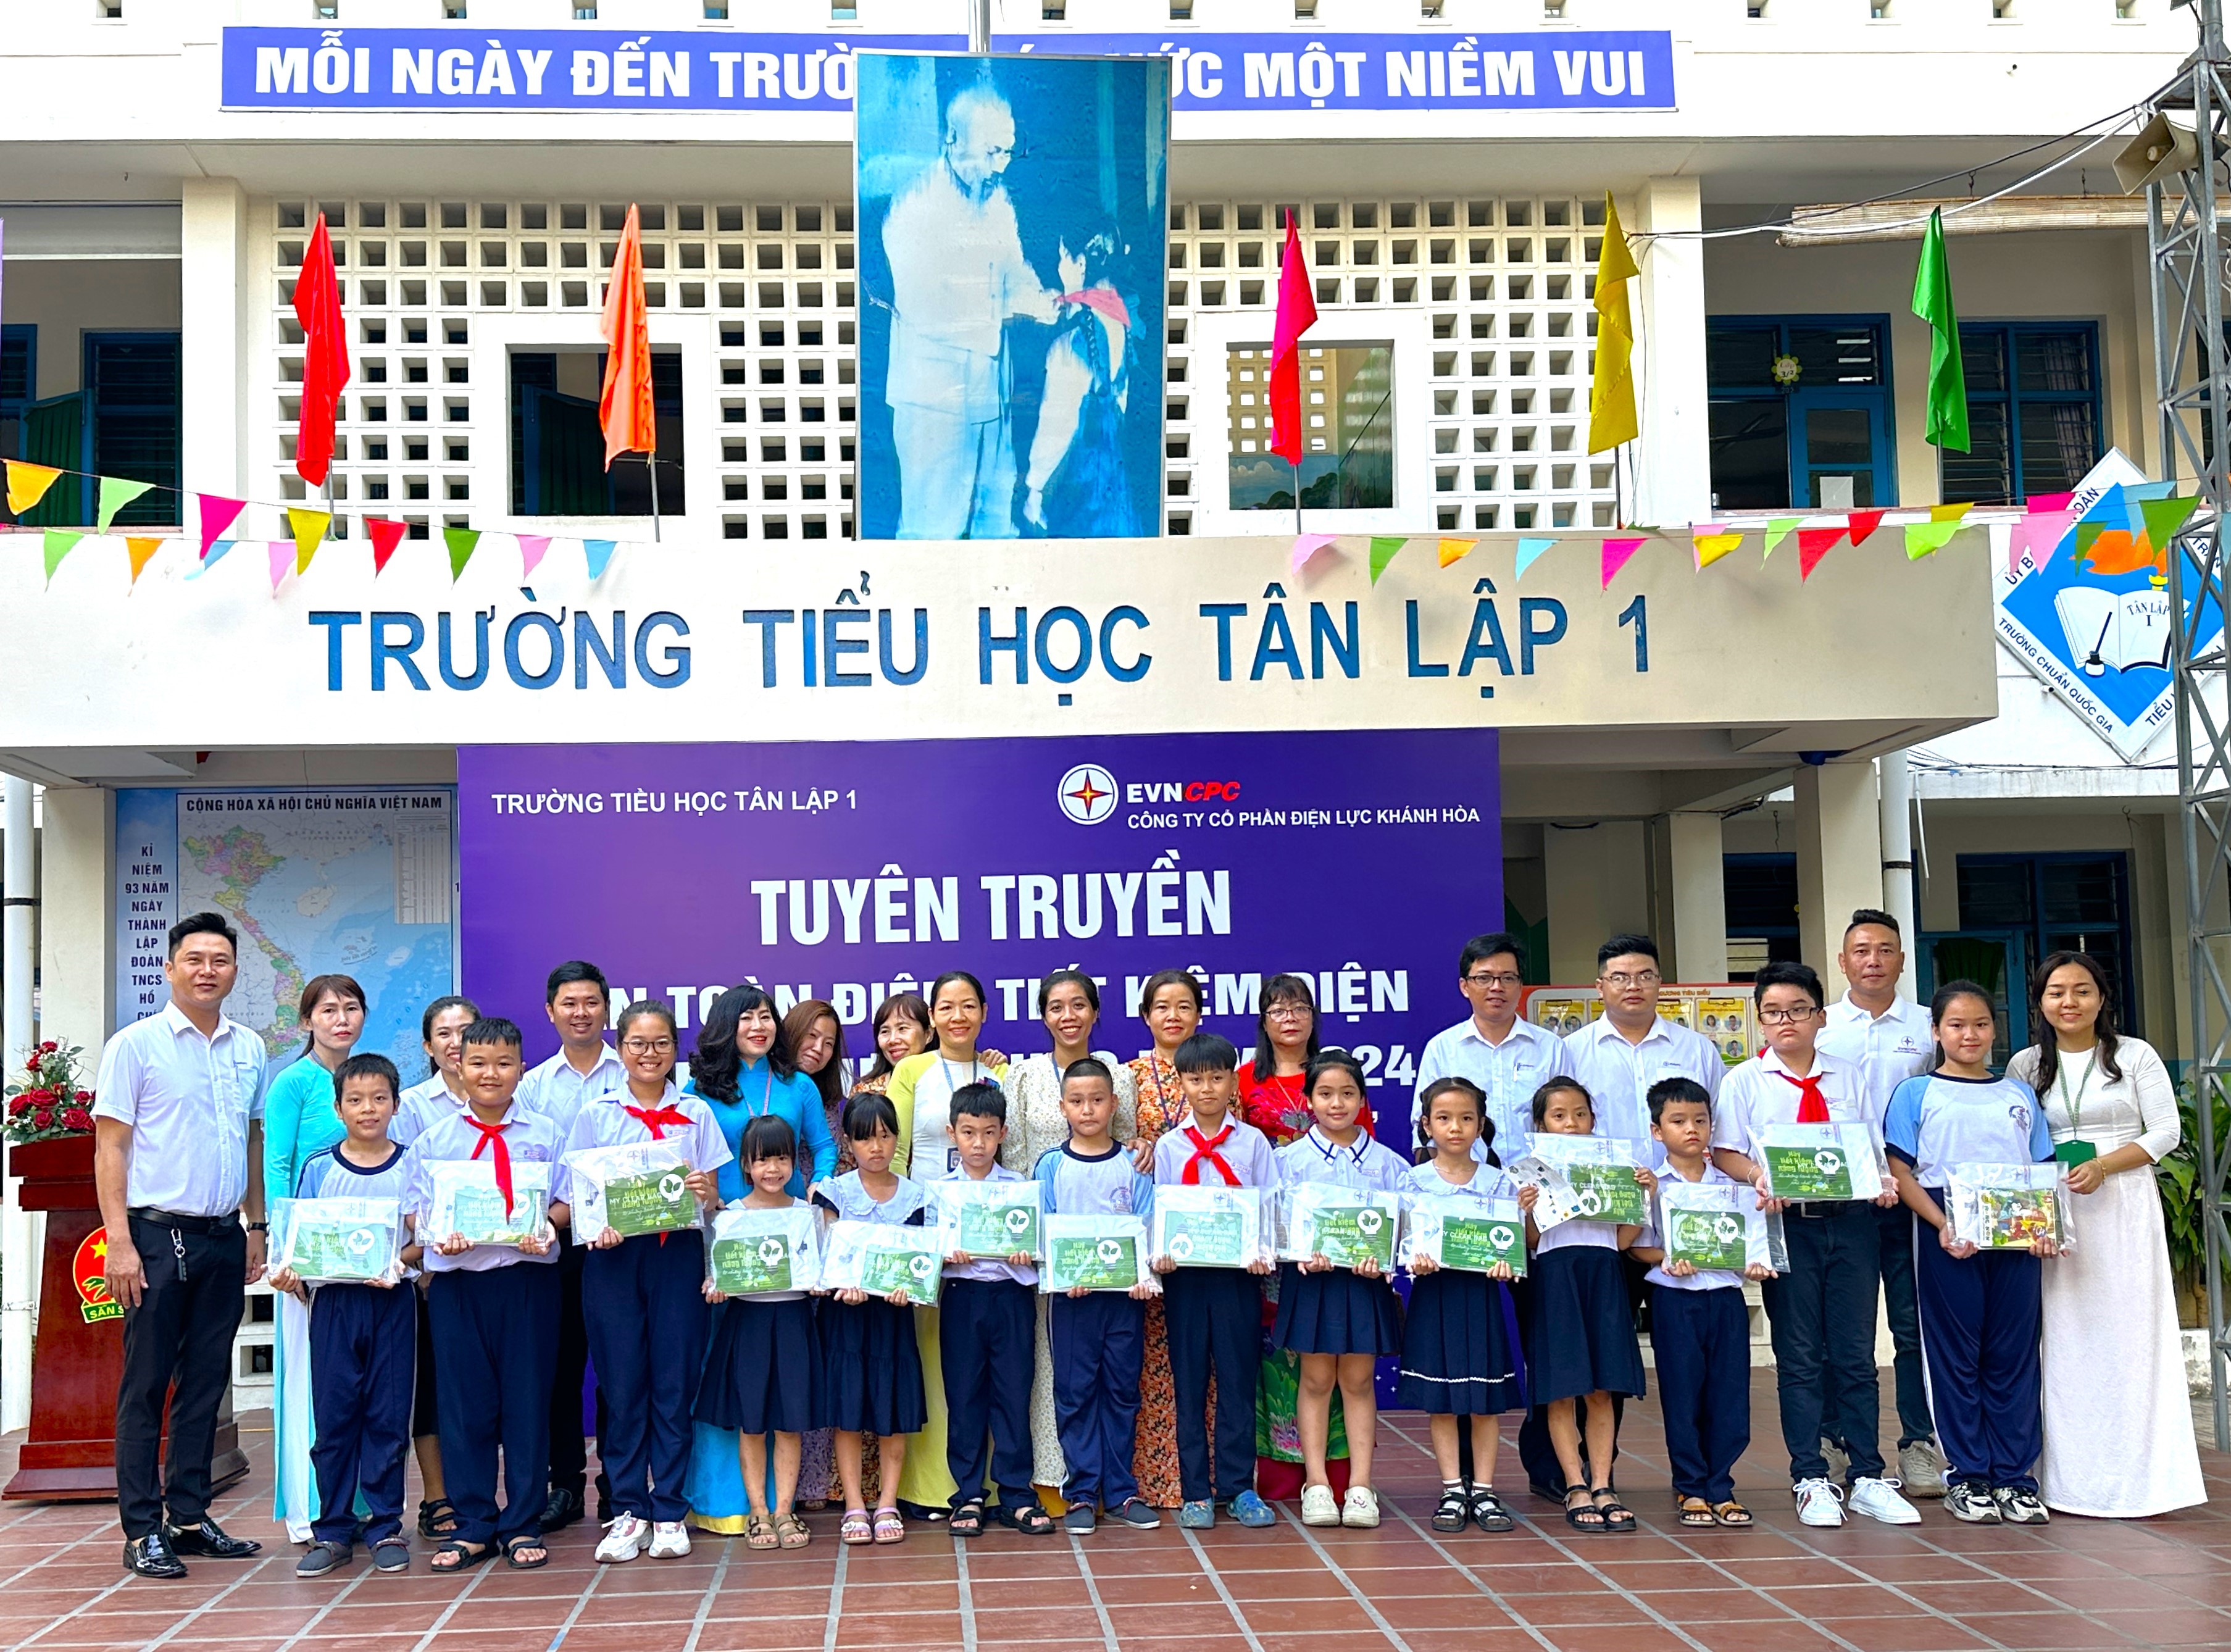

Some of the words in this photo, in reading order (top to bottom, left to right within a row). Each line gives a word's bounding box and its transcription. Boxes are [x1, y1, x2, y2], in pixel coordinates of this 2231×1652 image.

[256, 30, 370, 94] MỖI
[392, 39, 553, 95] NGÀY
[570, 36, 690, 97] ĐẾN
[710, 42, 854, 100] TRƯỜ
[1243, 42, 1367, 107] MỘT
[1386, 36, 1535, 97] NIỀM
[1553, 51, 1645, 96] VUI
[2074, 487, 2100, 515] DÂN
[2127, 599, 2148, 615] TÂN
[308, 587, 691, 691] TRƯỜNG
[743, 570, 928, 688] TIỂU
[978, 605, 1153, 706] HỌC
[1199, 582, 1377, 682] TÂN
[1406, 578, 1568, 699] LẬP
[1618, 594, 1649, 673] 1
[1999, 617, 2037, 657] TRƯỜNG
[2037, 656, 2070, 690] CHUẨN
[2069, 688, 2096, 715] QUỐC
[2096, 714, 2113, 733] GIA
[2145, 699, 2173, 726] TIỂU
[186, 797, 223, 813] CỘNG
[227, 796, 254, 811] HÒA
[257, 796, 275, 811] XÃ
[278, 796, 301, 812] HỘI
[305, 795, 332, 809] CHỦ
[335, 796, 377, 810] NGHĨA
[379, 795, 409, 812] VIỆT
[411, 796, 442, 809] NAM
[491, 788, 603, 814] TRƯỜNG
[674, 791, 727, 817] HỌC
[733, 786, 783, 811] TÂN
[791, 786, 838, 815] LẬP
[846, 790, 856, 809] 1
[1127, 811, 1178, 829] CÔNG
[1182, 812, 1204, 827] TY
[1290, 809, 1330, 828] ĐIỆN
[1336, 809, 1372, 827] LỰC
[1377, 804, 1437, 824] KHÁNH
[1442, 804, 1480, 822] HÒA
[141, 842, 153, 857] KỈ
[132, 862, 162, 877] NIỆM
[125, 883, 139, 894] 93
[142, 881, 169, 894] NĂM
[131, 899, 163, 912] NGÀY
[751, 864, 959, 945] TUYÊN
[980, 849, 1230, 940] TRUYỀN
[128, 917, 166, 930] THÀNH
[136, 935, 158, 951] LẬP
[131, 954, 163, 967] ĐOÀN
[131, 975, 162, 986] TNCS
[665, 975, 812, 1030] TON
[1283, 961, 1409, 1022] IỆN
